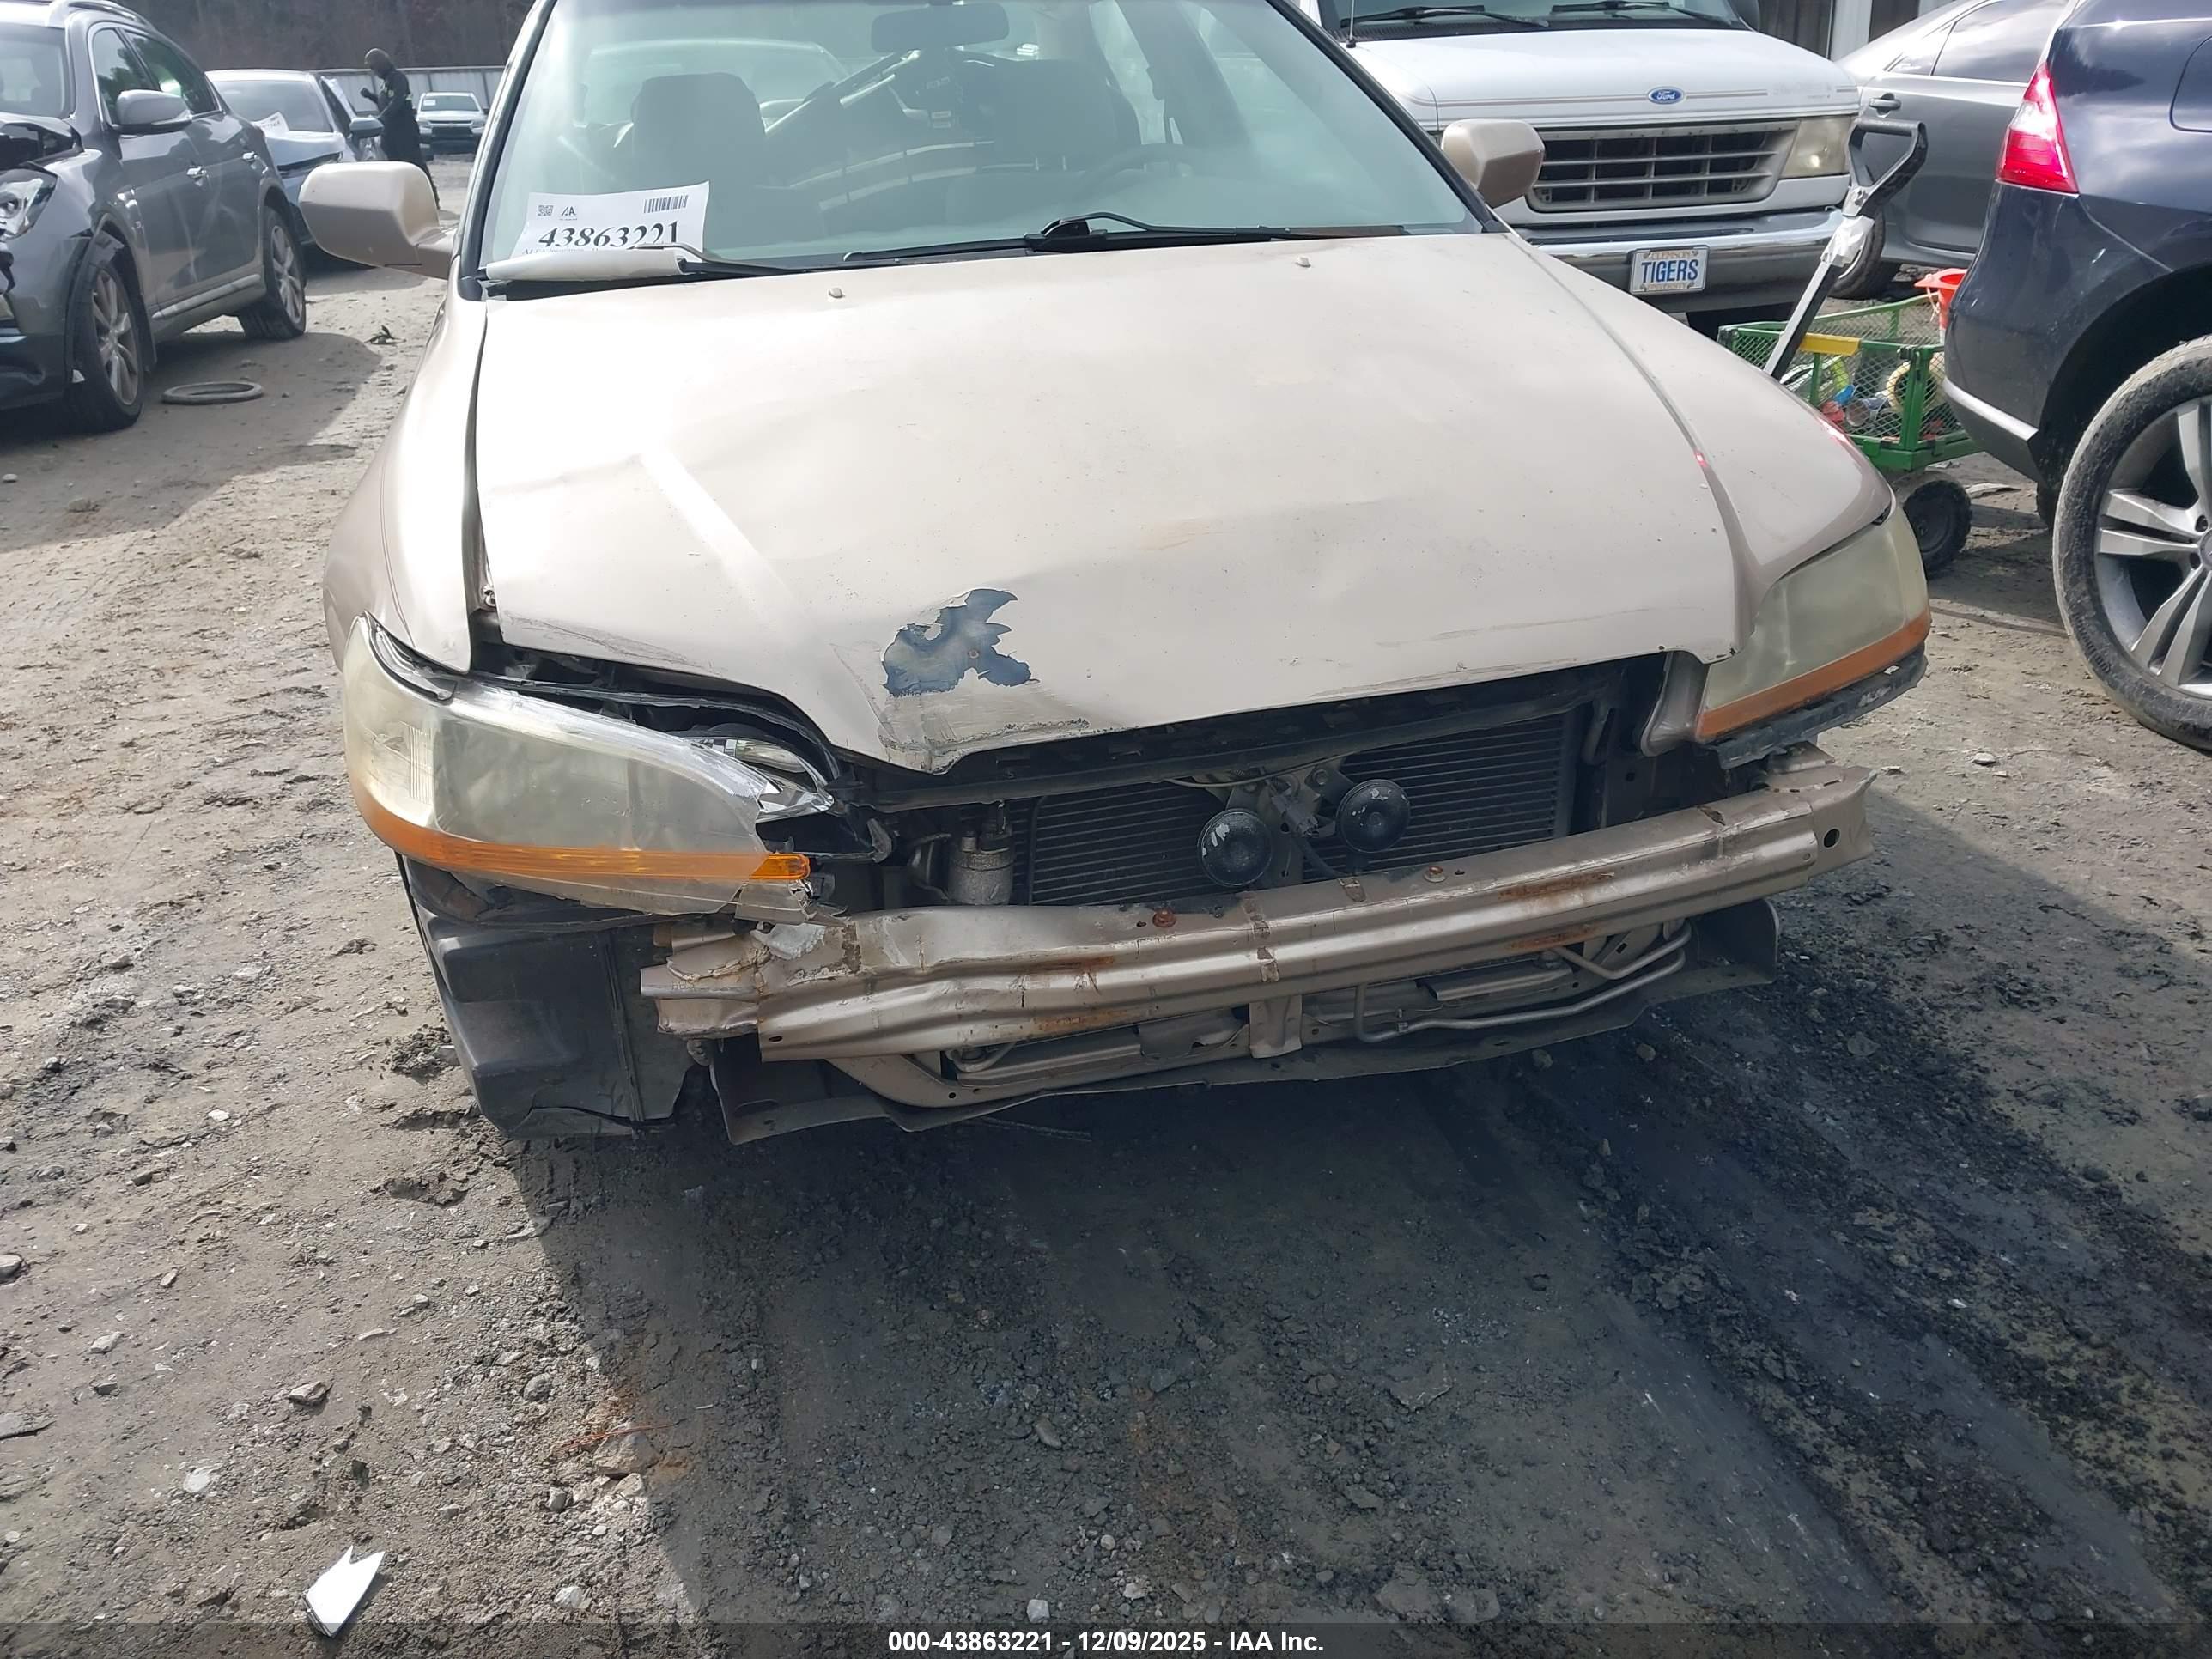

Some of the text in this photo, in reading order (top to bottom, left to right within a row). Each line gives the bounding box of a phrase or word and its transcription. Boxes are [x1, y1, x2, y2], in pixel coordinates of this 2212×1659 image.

[1656, 90, 1675, 100] Ford
[538, 220, 678, 247] 43863221
[1641, 259, 1698, 283] TIGERS
